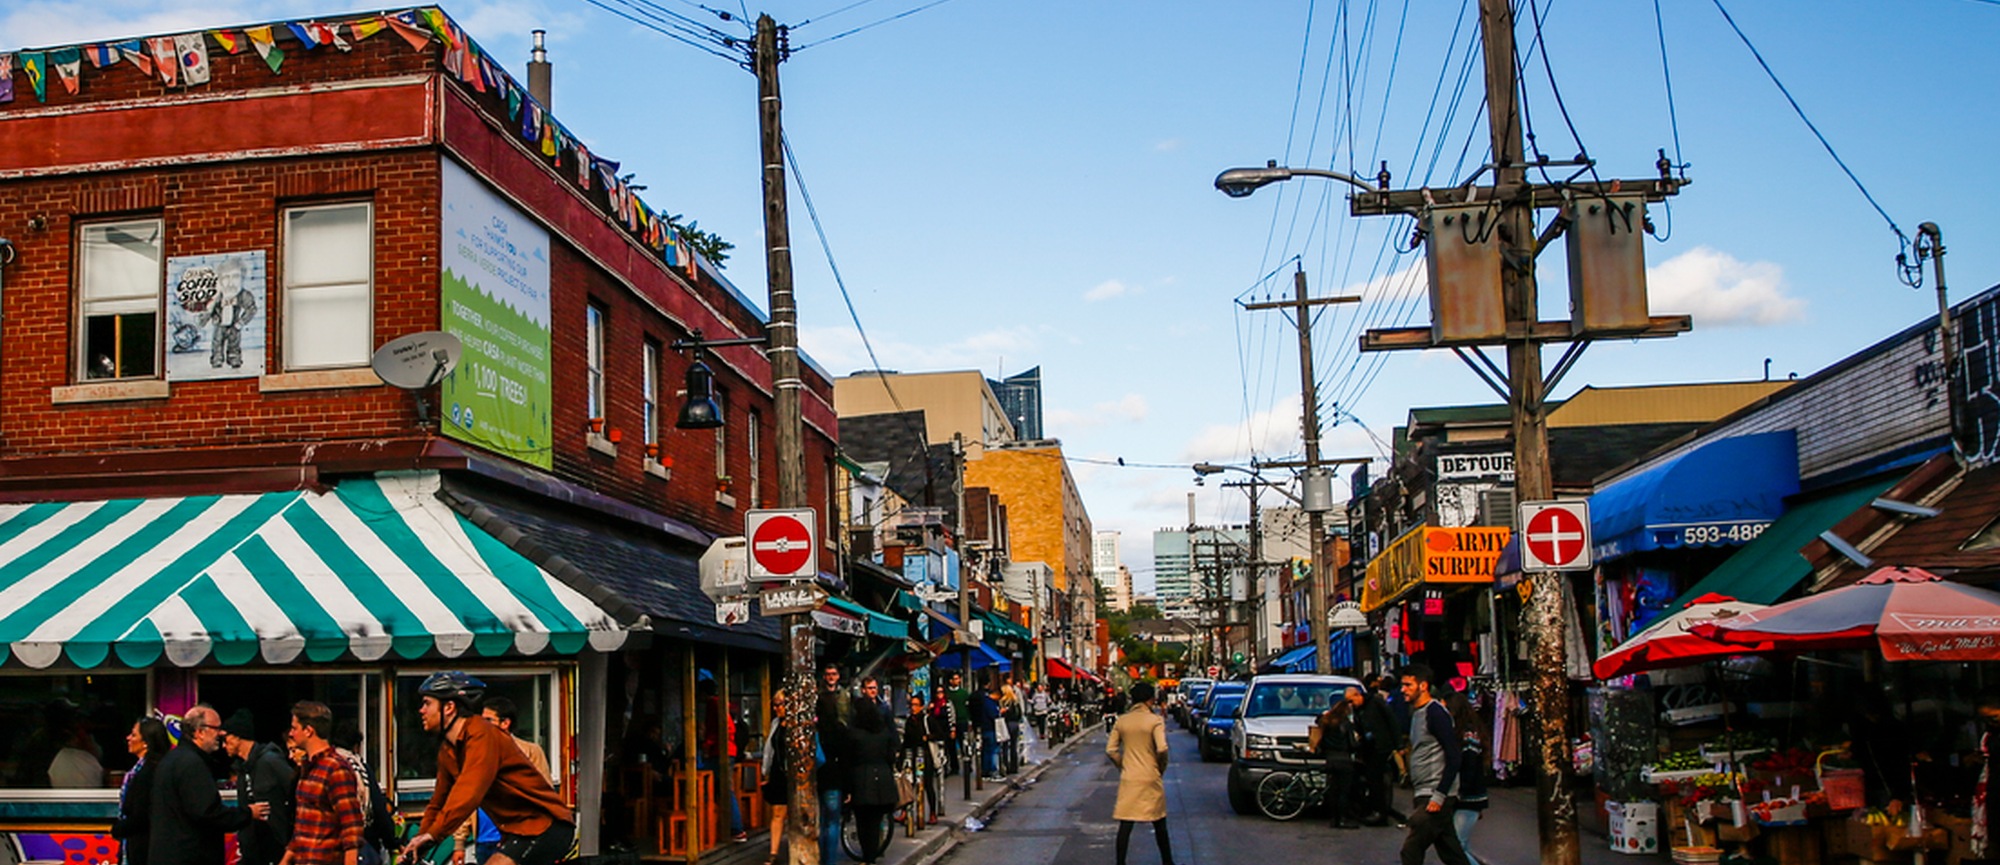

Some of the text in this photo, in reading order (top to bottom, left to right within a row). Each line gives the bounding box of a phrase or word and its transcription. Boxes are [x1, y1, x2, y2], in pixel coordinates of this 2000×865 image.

[492, 216, 507, 233] CASA
[483, 226, 516, 255] THANKS YOU
[471, 234, 526, 277] FOR SUPPORTING OUR
[177, 277, 218, 292] COFFEE
[497, 267, 518, 287] PROJECT
[180, 289, 217, 302] STOP
[485, 319, 497, 336] YOUR
[498, 327, 515, 345] COFFEE
[483, 341, 499, 361] CASA
[473, 363, 496, 393] 1,100
[1443, 456, 1514, 472] DETOUR
[1452, 533, 1506, 552] ARMY
[1428, 556, 1497, 576] SURPLU
[1955, 636, 1981, 649] Mill
